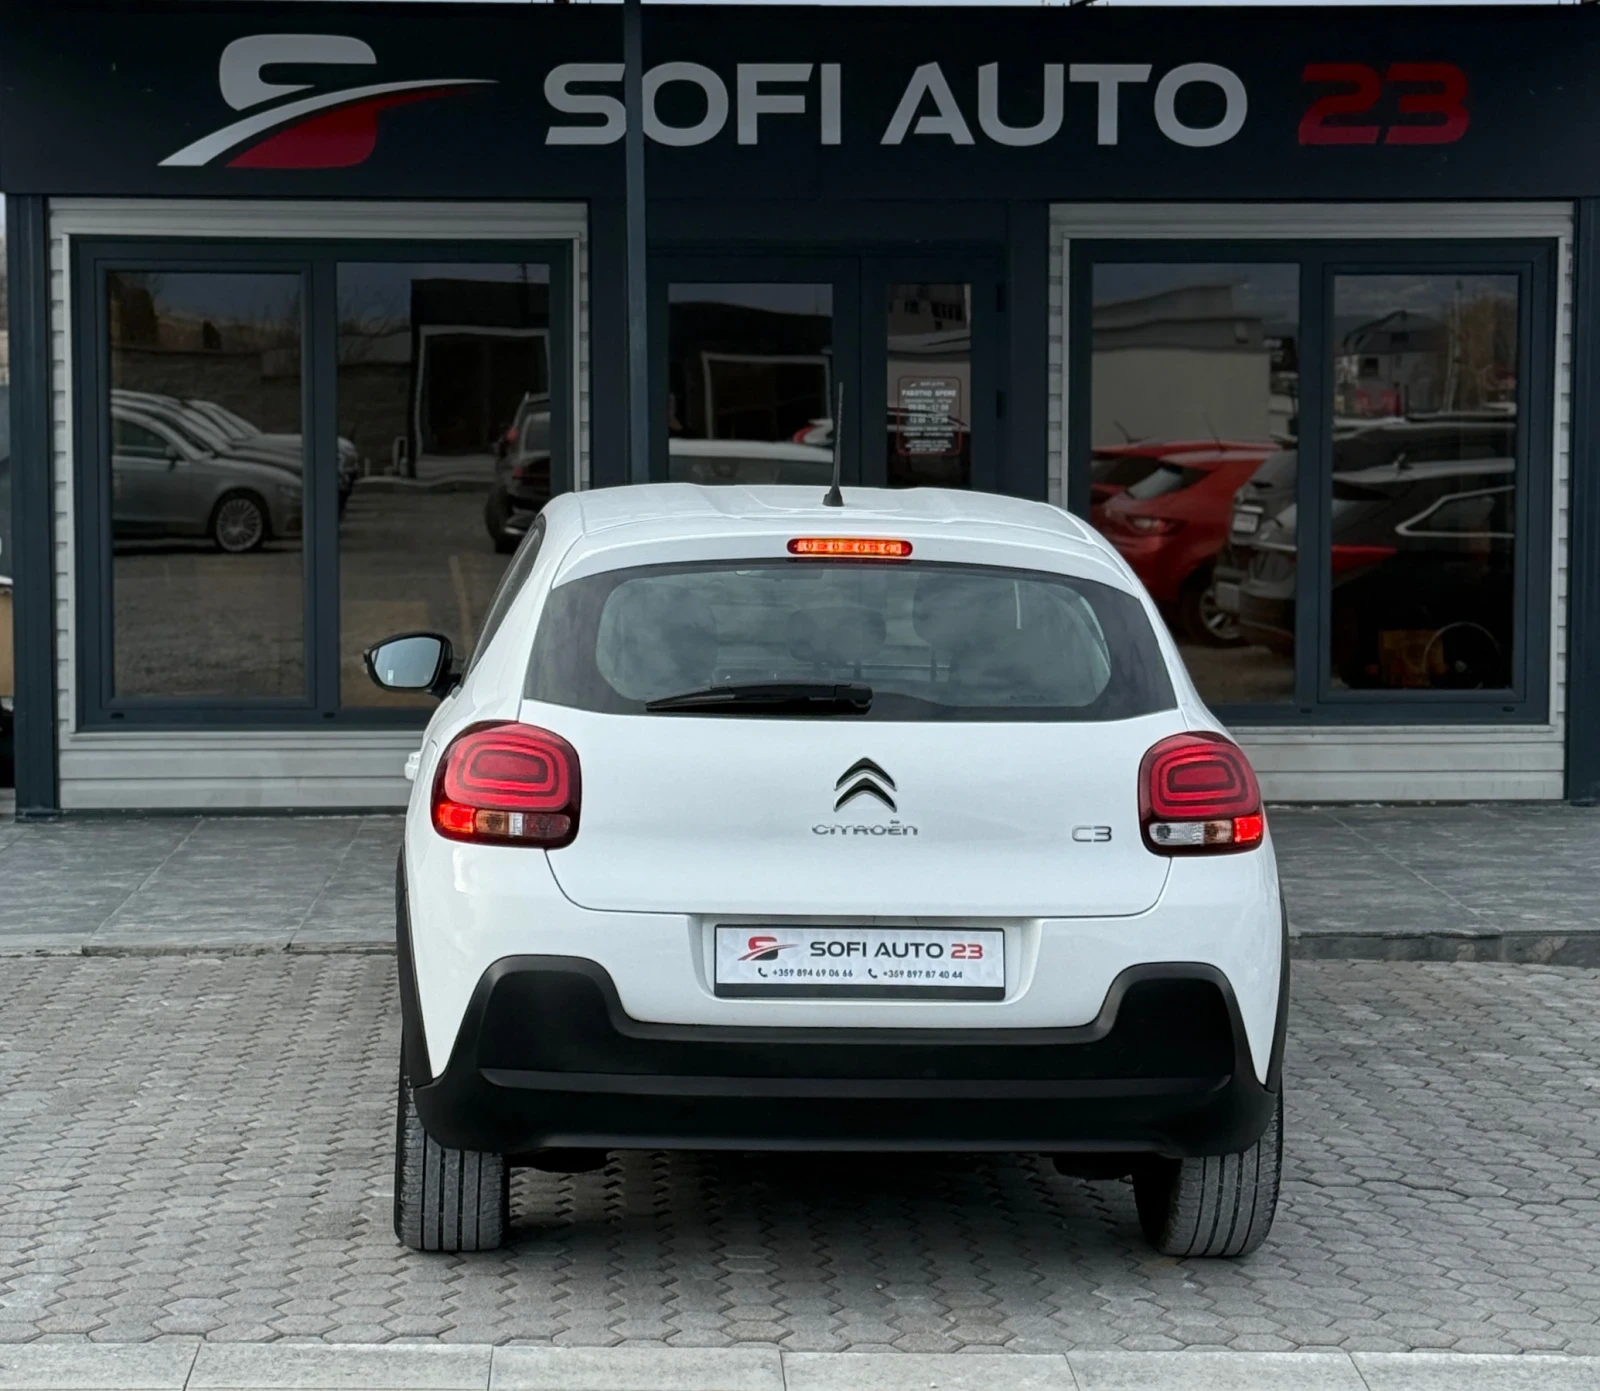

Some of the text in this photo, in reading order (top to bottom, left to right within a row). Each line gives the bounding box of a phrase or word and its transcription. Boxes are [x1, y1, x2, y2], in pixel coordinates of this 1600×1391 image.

[543, 61, 1471, 147] SOFI AUTO 23
[1071, 824, 1112, 843] C3
[809, 941, 984, 960] SOFI AUTO 23
[772, 968, 854, 977] +359 894 69 06 66
[883, 969, 963, 979] +359 897 87 40 44
